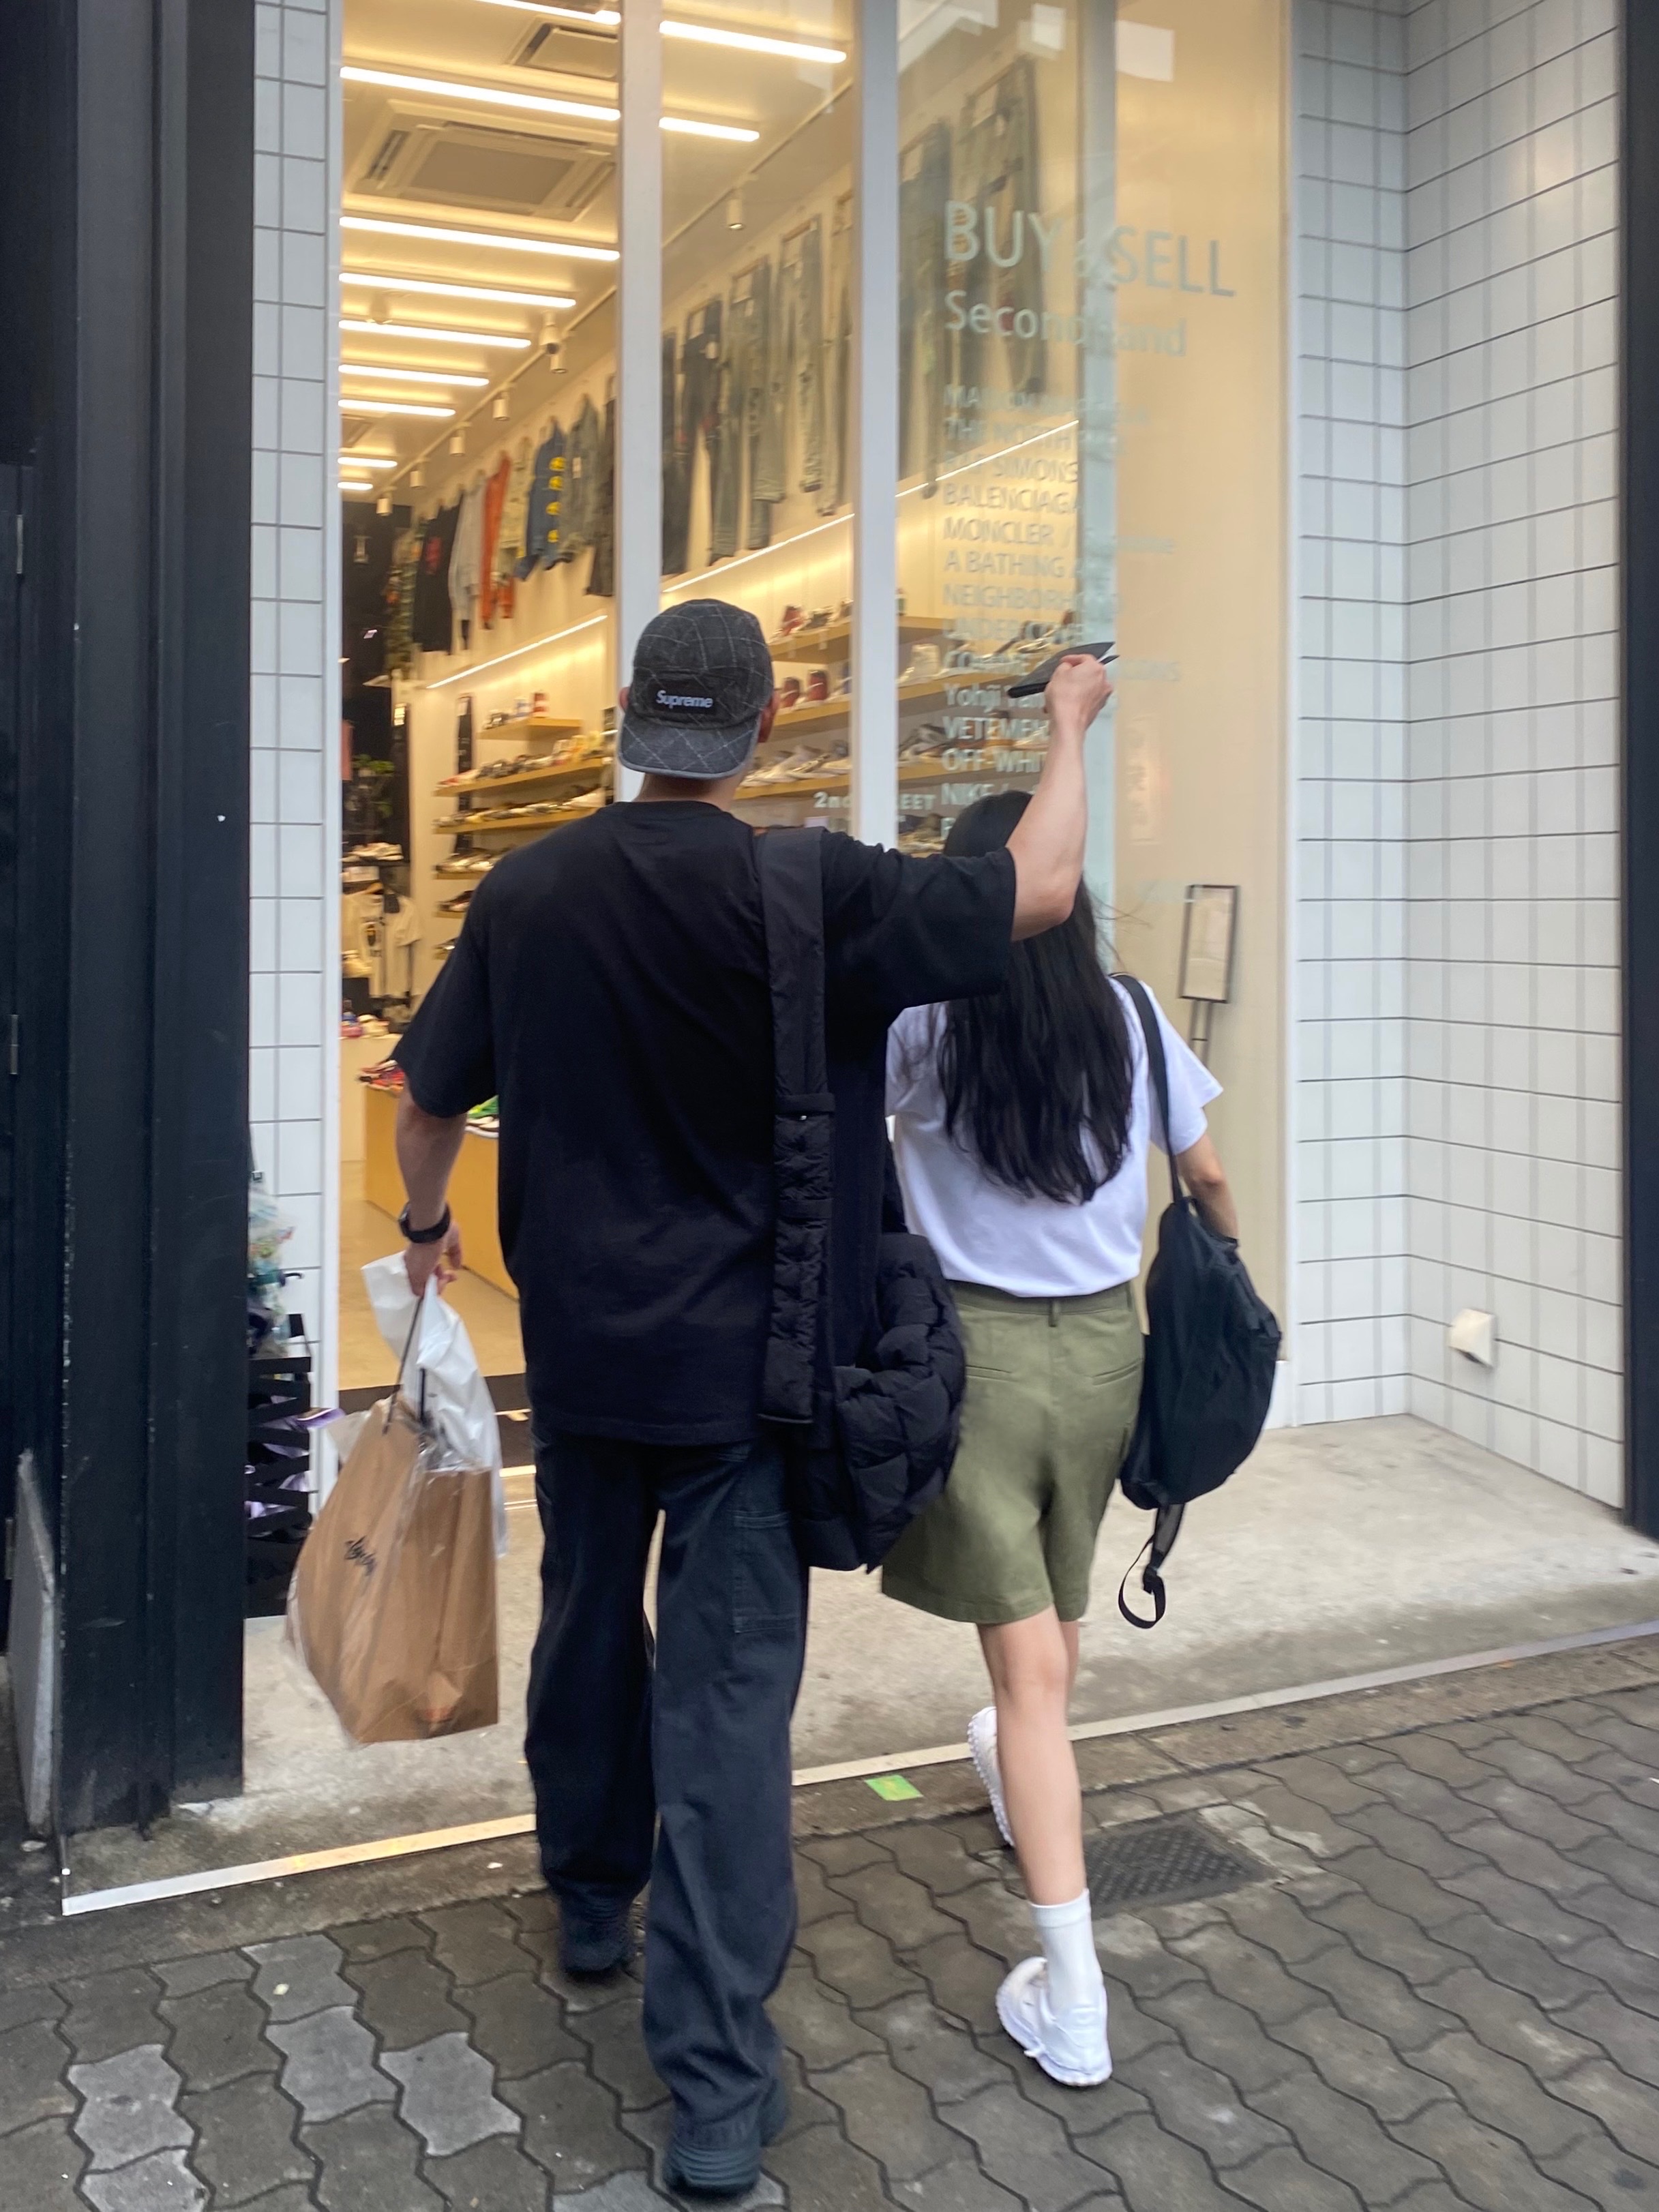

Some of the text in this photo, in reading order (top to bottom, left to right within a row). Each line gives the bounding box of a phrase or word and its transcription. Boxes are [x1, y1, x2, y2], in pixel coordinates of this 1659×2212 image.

[944, 200, 1065, 272] BUY
[1105, 224, 1237, 297] SELL
[945, 289, 1187, 357] Secondand
[943, 516, 1055, 546] MONCLER
[944, 548, 962, 573] A
[966, 554, 1065, 580] BATHING
[943, 582, 1118, 619] NEIGHBORH
[656, 689, 714, 709] Supreme
[944, 682, 1001, 713] Yohji
